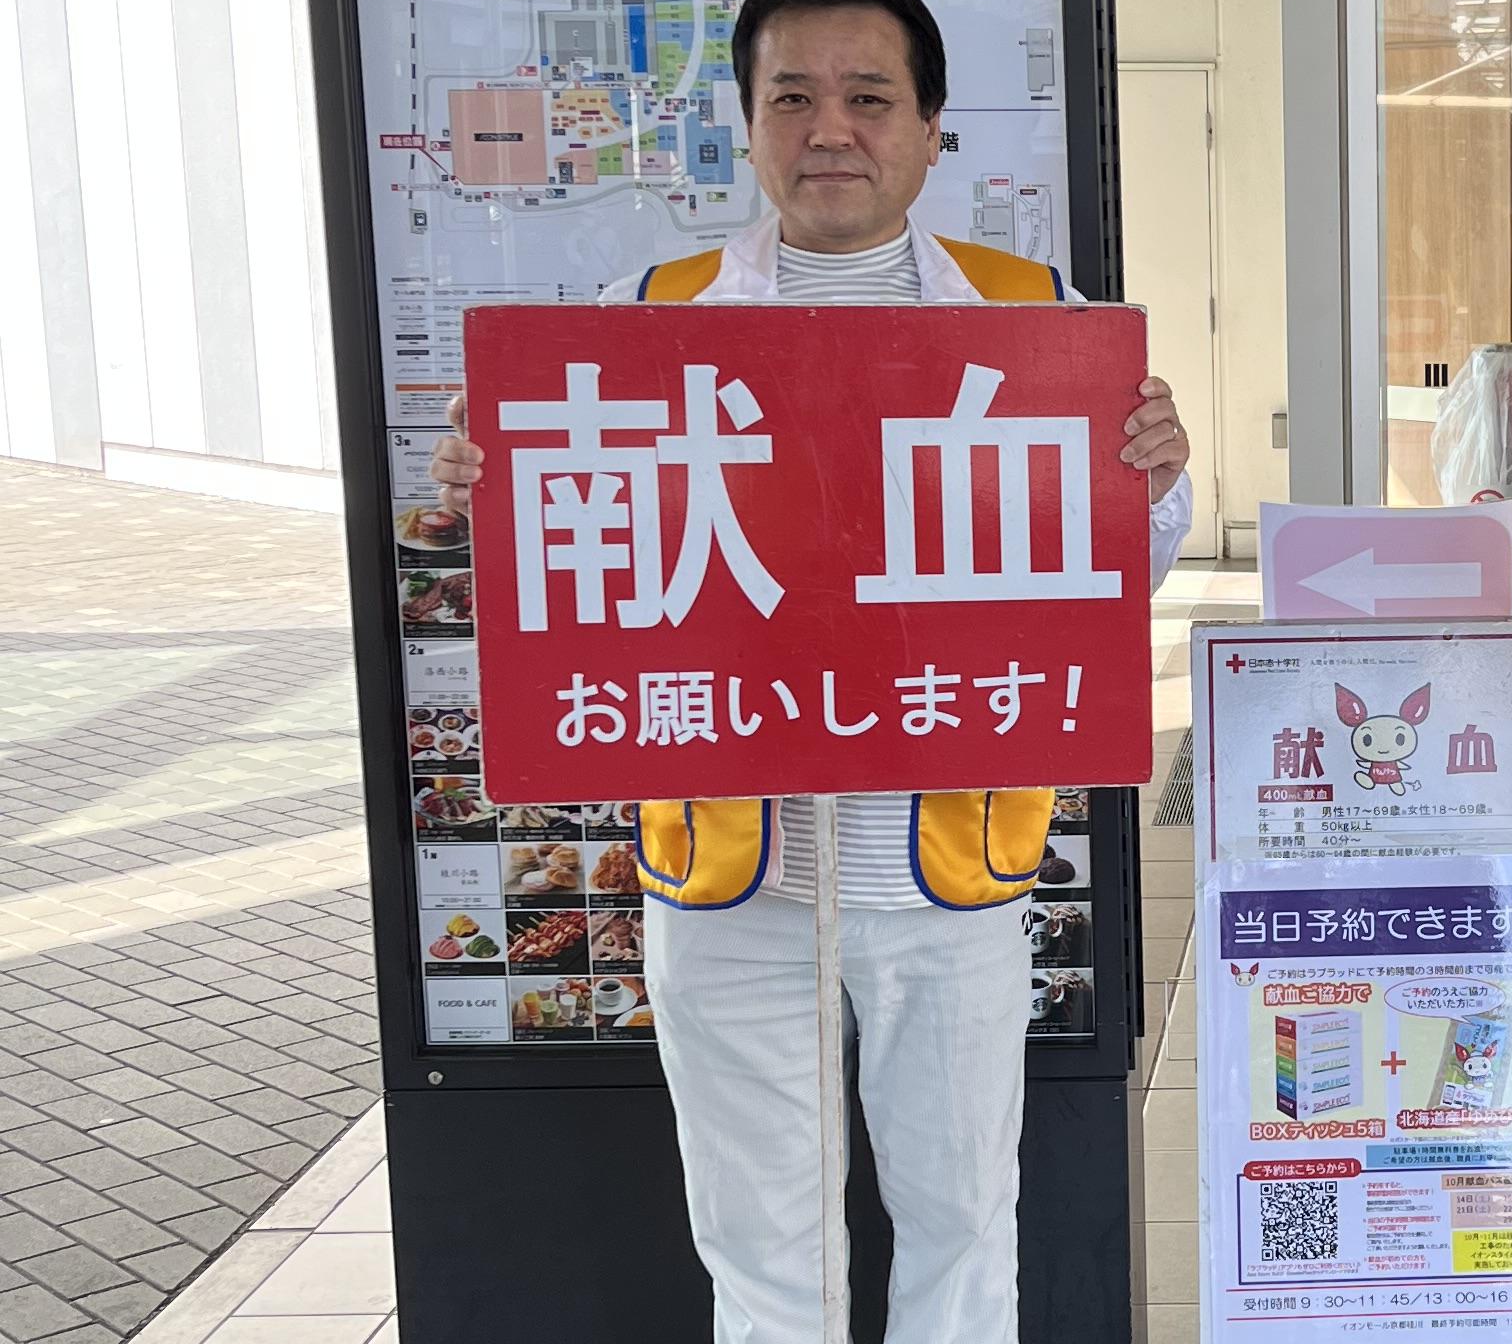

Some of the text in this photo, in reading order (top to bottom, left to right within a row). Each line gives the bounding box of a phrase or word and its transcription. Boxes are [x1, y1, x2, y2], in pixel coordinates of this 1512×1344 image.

[497, 362, 1123, 632] 献血
[554, 660, 1084, 748] お願いします！
[1321, 820, 1373, 833] 50kg以上
[1258, 836, 1306, 847] 所要時間
[1264, 983, 1372, 1006] 献血ご協力で
[1402, 986, 1489, 998] ご予約のうえご協力
[438, 999, 464, 1008] FOOD
[475, 999, 497, 1008] CAFE
[1250, 1119, 1386, 1140] BOXティッシュ5箱
[1250, 1161, 1356, 1177] ご予約はこちらから！
[1340, 1320, 1424, 1331] イオンモール京都桂川
